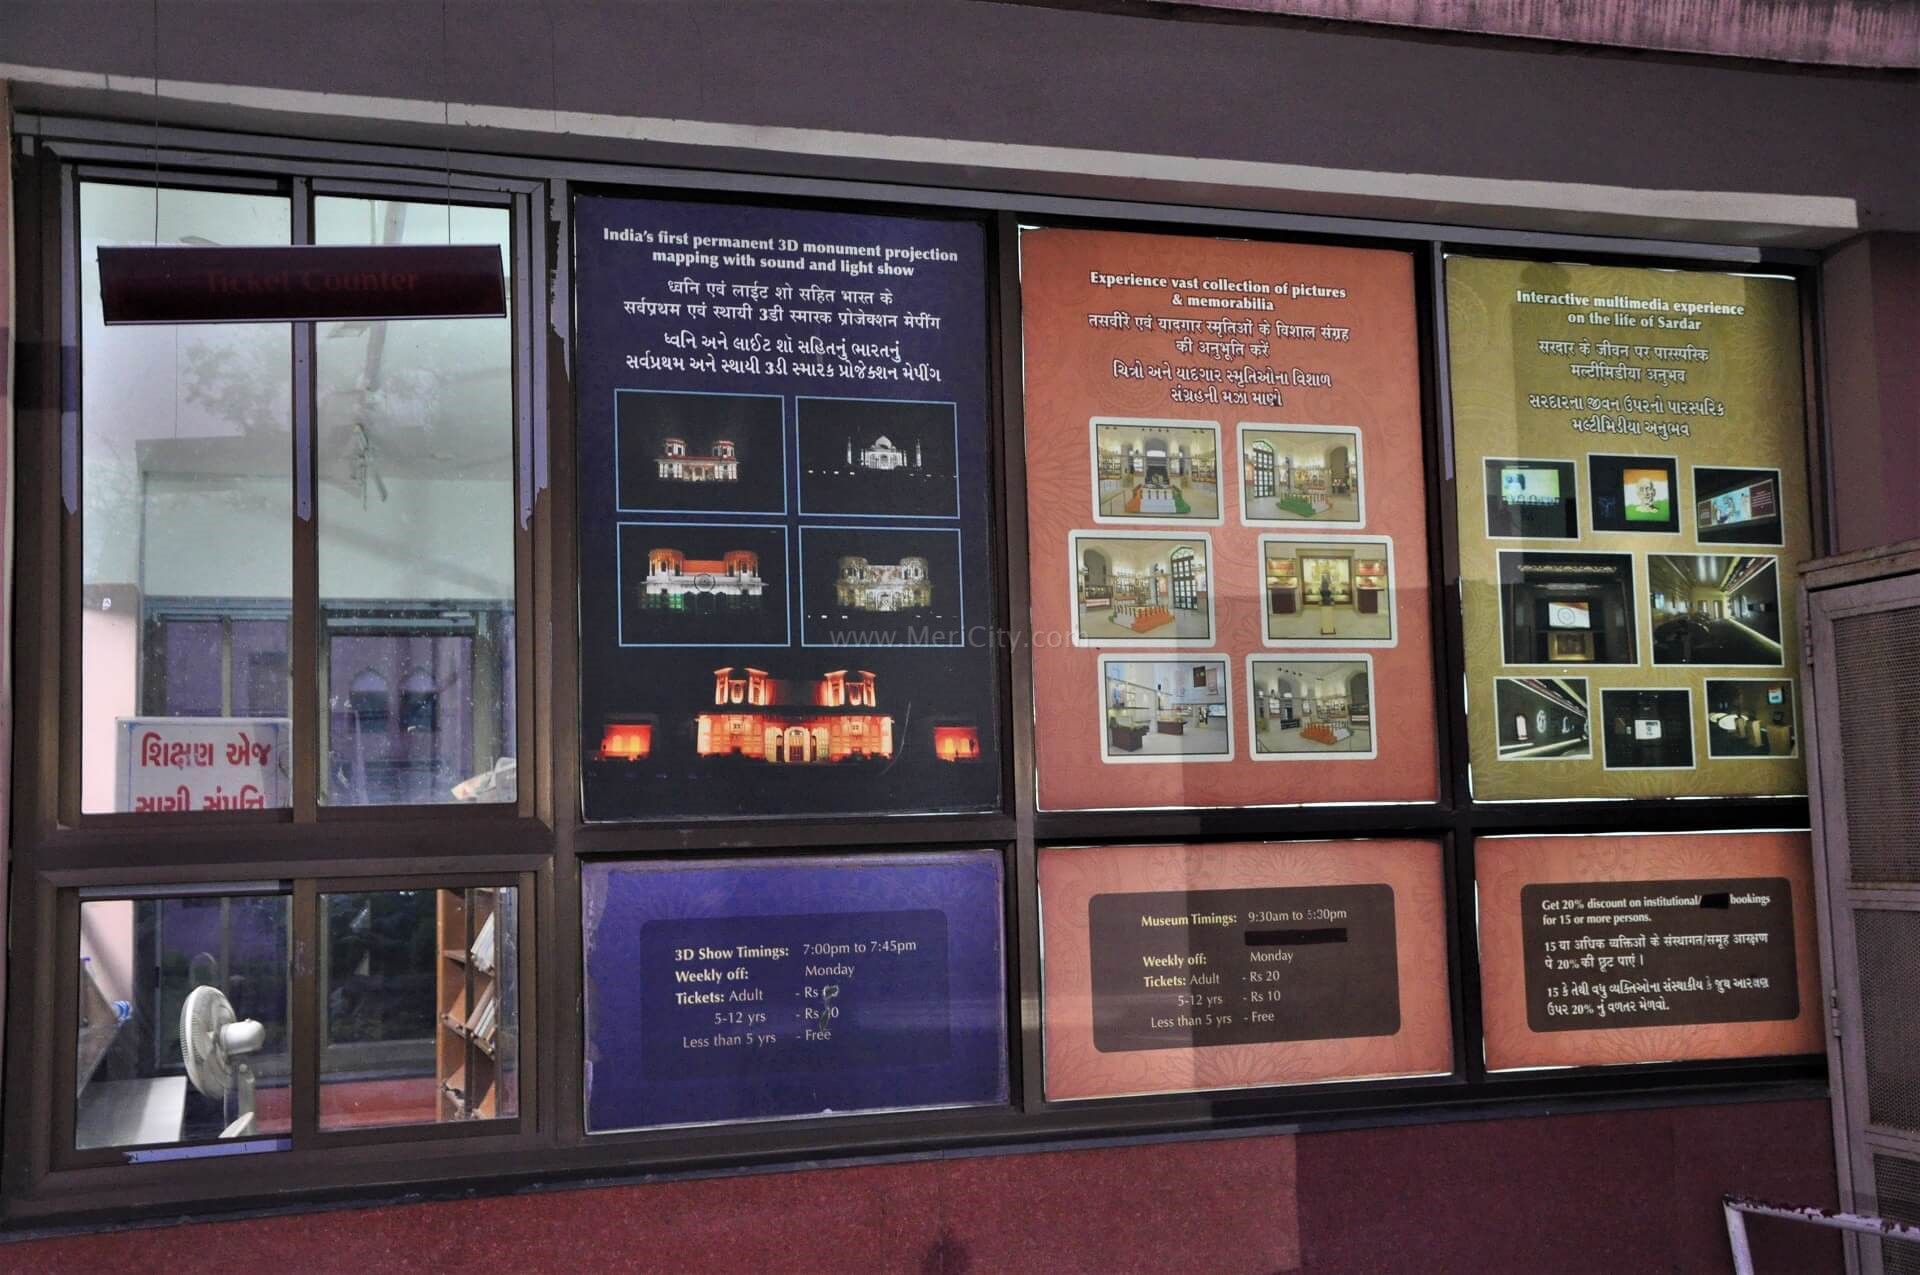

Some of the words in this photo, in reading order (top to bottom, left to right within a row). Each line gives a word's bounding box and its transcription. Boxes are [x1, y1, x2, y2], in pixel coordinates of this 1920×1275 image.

[658, 230, 689, 245] first
[693, 235, 774, 250] permanent
[778, 239, 799, 252] 3D
[803, 242, 881, 257] monument
[885, 246, 958, 263] projection
[652, 250, 720, 268] mapping
[723, 253, 756, 267] with
[760, 257, 805, 270] sound
[809, 259, 836, 272] and
[841, 260, 874, 277] light
[877, 263, 915, 277] show
[304, 269, 418, 293] Counter
[667, 276, 700, 295] ध्वनि
[706, 280, 726, 298] एवं
[732, 281, 769, 302] लाईट
[774, 283, 793, 300] शो
[799, 283, 836, 304] सहित
[841, 290, 875, 304] भारत
[879, 288, 894, 305] के
[1090, 271, 1168, 288] Experience
[1171, 277, 1199, 290] vast
[1202, 277, 1270, 295] collection
[1274, 282, 1288, 295] of
[1291, 284, 1347, 299] pictures
[623, 297, 682, 316] सर्वप्रथम
[687, 301, 707, 319] एवं
[713, 303, 753, 320] स्थायी
[789, 309, 832, 324] स्मारक
[838, 308, 898, 327] प्रोजेक्शन
[1172, 294, 1183, 306] &
[1187, 294, 1275, 312] memorabilia
[1516, 290, 1589, 307] Interactive
[1594, 295, 1669, 312] multimedia
[1673, 301, 1744, 316] experience
[1135, 314, 1153, 331] एवं
[1158, 318, 1203, 333] यादगार
[1258, 319, 1271, 336] के
[1275, 320, 1316, 339] विशाल
[1320, 324, 1350, 341] संग्रह
[1568, 313, 1585, 324] on
[1590, 312, 1611, 326] the
[1615, 313, 1637, 327] life
[1641, 316, 1653, 328] of
[1658, 317, 1701, 331] Sardar
[664, 329, 698, 349] ધ્વનિ
[701, 331, 728, 350] અને
[733, 333, 772, 352] લાઈટ
[798, 336, 848, 361] સહિતનું
[851, 340, 901, 363] ભારતનું
[1175, 336, 1193, 353] की
[1199, 338, 1245, 361] अनुभूति
[1249, 340, 1270, 357] करें
[1538, 340, 1575, 354] सरदार
[1579, 338, 1590, 355] के
[1596, 339, 1629, 357] जीवन
[1634, 346, 1650, 358] पर
[626, 350, 685, 371] સર્વપ્રથમ
[689, 353, 717, 373] અને
[721, 355, 761, 375] સ્થાયી
[792, 361, 834, 378] સ્મારક
[839, 359, 899, 381] પ્રોજેક્શન
[1148, 361, 1173, 380] અને
[1176, 366, 1222, 382] યાદગાર
[1292, 368, 1332, 388] વિશાળ
[1647, 368, 1686, 387] अनुभव
[1171, 384, 1219, 403] સંગ્રહની
[1529, 395, 1584, 410] સરદારના
[1587, 397, 1620, 411] જીવન
[1645, 421, 1690, 441] અનુભવ
[141, 731, 214, 770] શિક્ષણ
[225, 732, 272, 767] એજ
[1542, 899, 1560, 911] Get
[1563, 898, 1584, 909] 20%
[1587, 897, 1627, 909] discount
[1629, 899, 1641, 908] on
[1729, 893, 1771, 907] bookings
[1141, 914, 1189, 927] Museum
[1191, 913, 1237, 926] Timings:
[1248, 911, 1289, 923] 9:30am
[1292, 911, 1303, 920] to
[1543, 914, 1557, 926] for
[1560, 914, 1571, 925] 15
[1574, 915, 1585, 924] or
[1587, 914, 1611, 924] more
[1613, 913, 1652, 925] persons.
[675, 948, 695, 961] 3D
[698, 947, 733, 960] Show
[736, 945, 790, 961] Timings:
[803, 943, 850, 957] 7:00pm
[854, 942, 866, 953] to
[870, 940, 917, 955] 7:45pm
[1544, 941, 1557, 952] 15
[1558, 940, 1571, 951] या
[1574, 936, 1606, 950] अधिक
[1650, 933, 1660, 947] के
[1143, 954, 1183, 968] Weekly
[1187, 953, 1207, 965] off:
[1250, 950, 1294, 964] Monday
[1557, 959, 1580, 970] 20%
[1580, 953, 1595, 968] की
[675, 969, 722, 985] Weekly
[727, 967, 749, 980] off:
[805, 963, 855, 979] Monday
[1144, 975, 1187, 987] Tickets:
[1189, 973, 1220, 985] Adult
[1250, 970, 1263, 982] Rs
[1265, 970, 1280, 981] 20
[675, 991, 725, 1005] Tickets:
[729, 989, 763, 1002] Adult
[804, 985, 819, 998] Rs
[1177, 994, 1202, 1006] 5-12
[1206, 995, 1223, 1008] yrs
[1251, 990, 1264, 1002] Rs
[1267, 990, 1281, 1002] 10
[1547, 987, 1559, 998] 15
[1571, 981, 1590, 996] તેથી
[714, 1011, 743, 1024] 5-12
[748, 1012, 766, 1026] yrs
[805, 1007, 820, 1020] Rs
[1547, 1001, 1569, 1016] ઉપર
[1571, 1004, 1595, 1015] 20%
[1151, 1016, 1174, 1028] Less
[1177, 1015, 1202, 1026] than
[1205, 1015, 1212, 1025] 5
[1216, 1014, 1232, 1029] yrs
[1251, 1011, 1275, 1023] Free
[683, 1035, 709, 1048] Less
[714, 1034, 742, 1046] than
[746, 1033, 753, 1044] 5
[758, 1033, 777, 1048] yrs
[805, 1029, 832, 1041] Free
